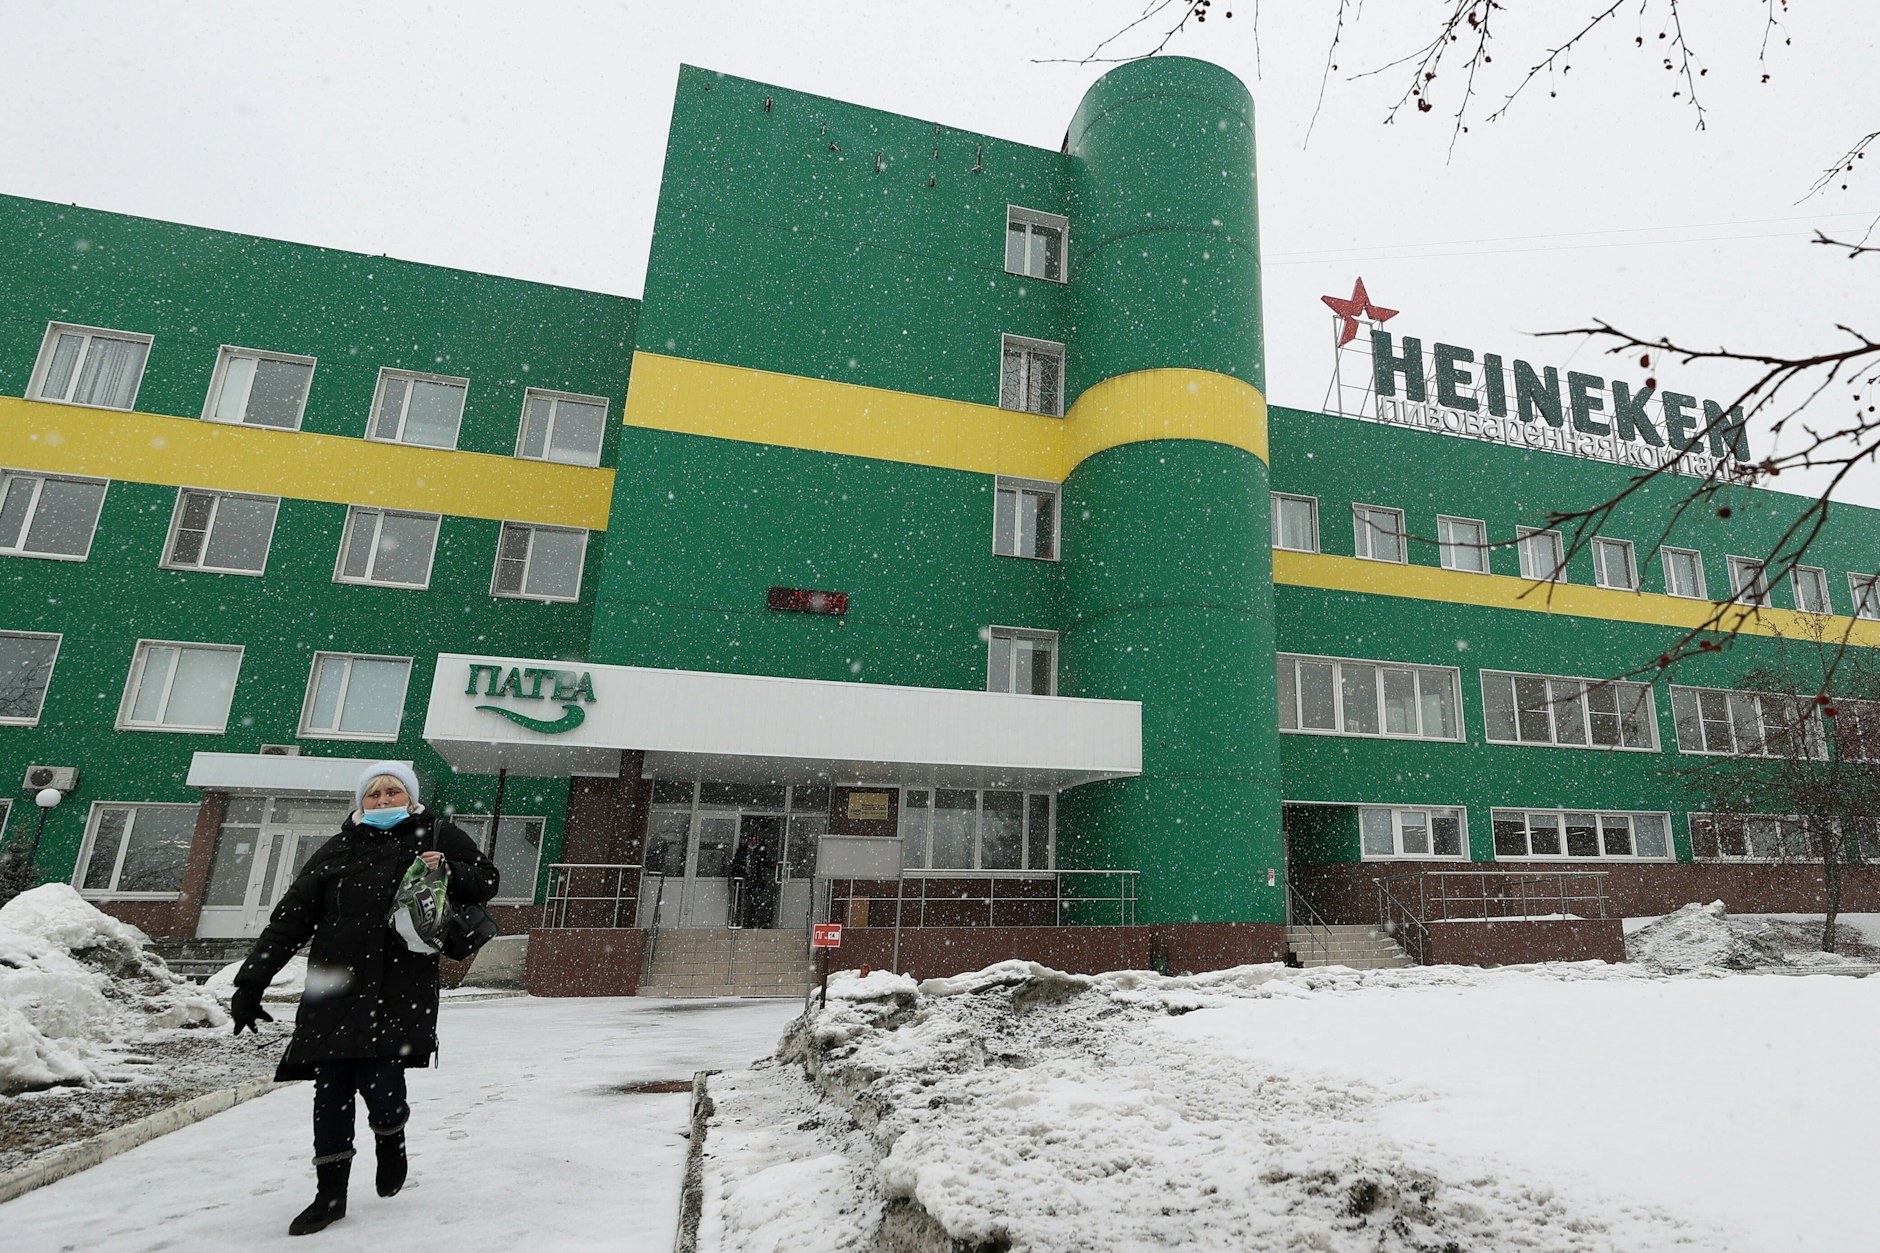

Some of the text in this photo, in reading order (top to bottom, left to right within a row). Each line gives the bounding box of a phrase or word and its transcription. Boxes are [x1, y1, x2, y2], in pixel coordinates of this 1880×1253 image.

[1370, 329, 1751, 463] HEINEKEN
[1380, 396, 1617, 460] пивоваренная
[464, 663, 598, 703] ПАТРА
